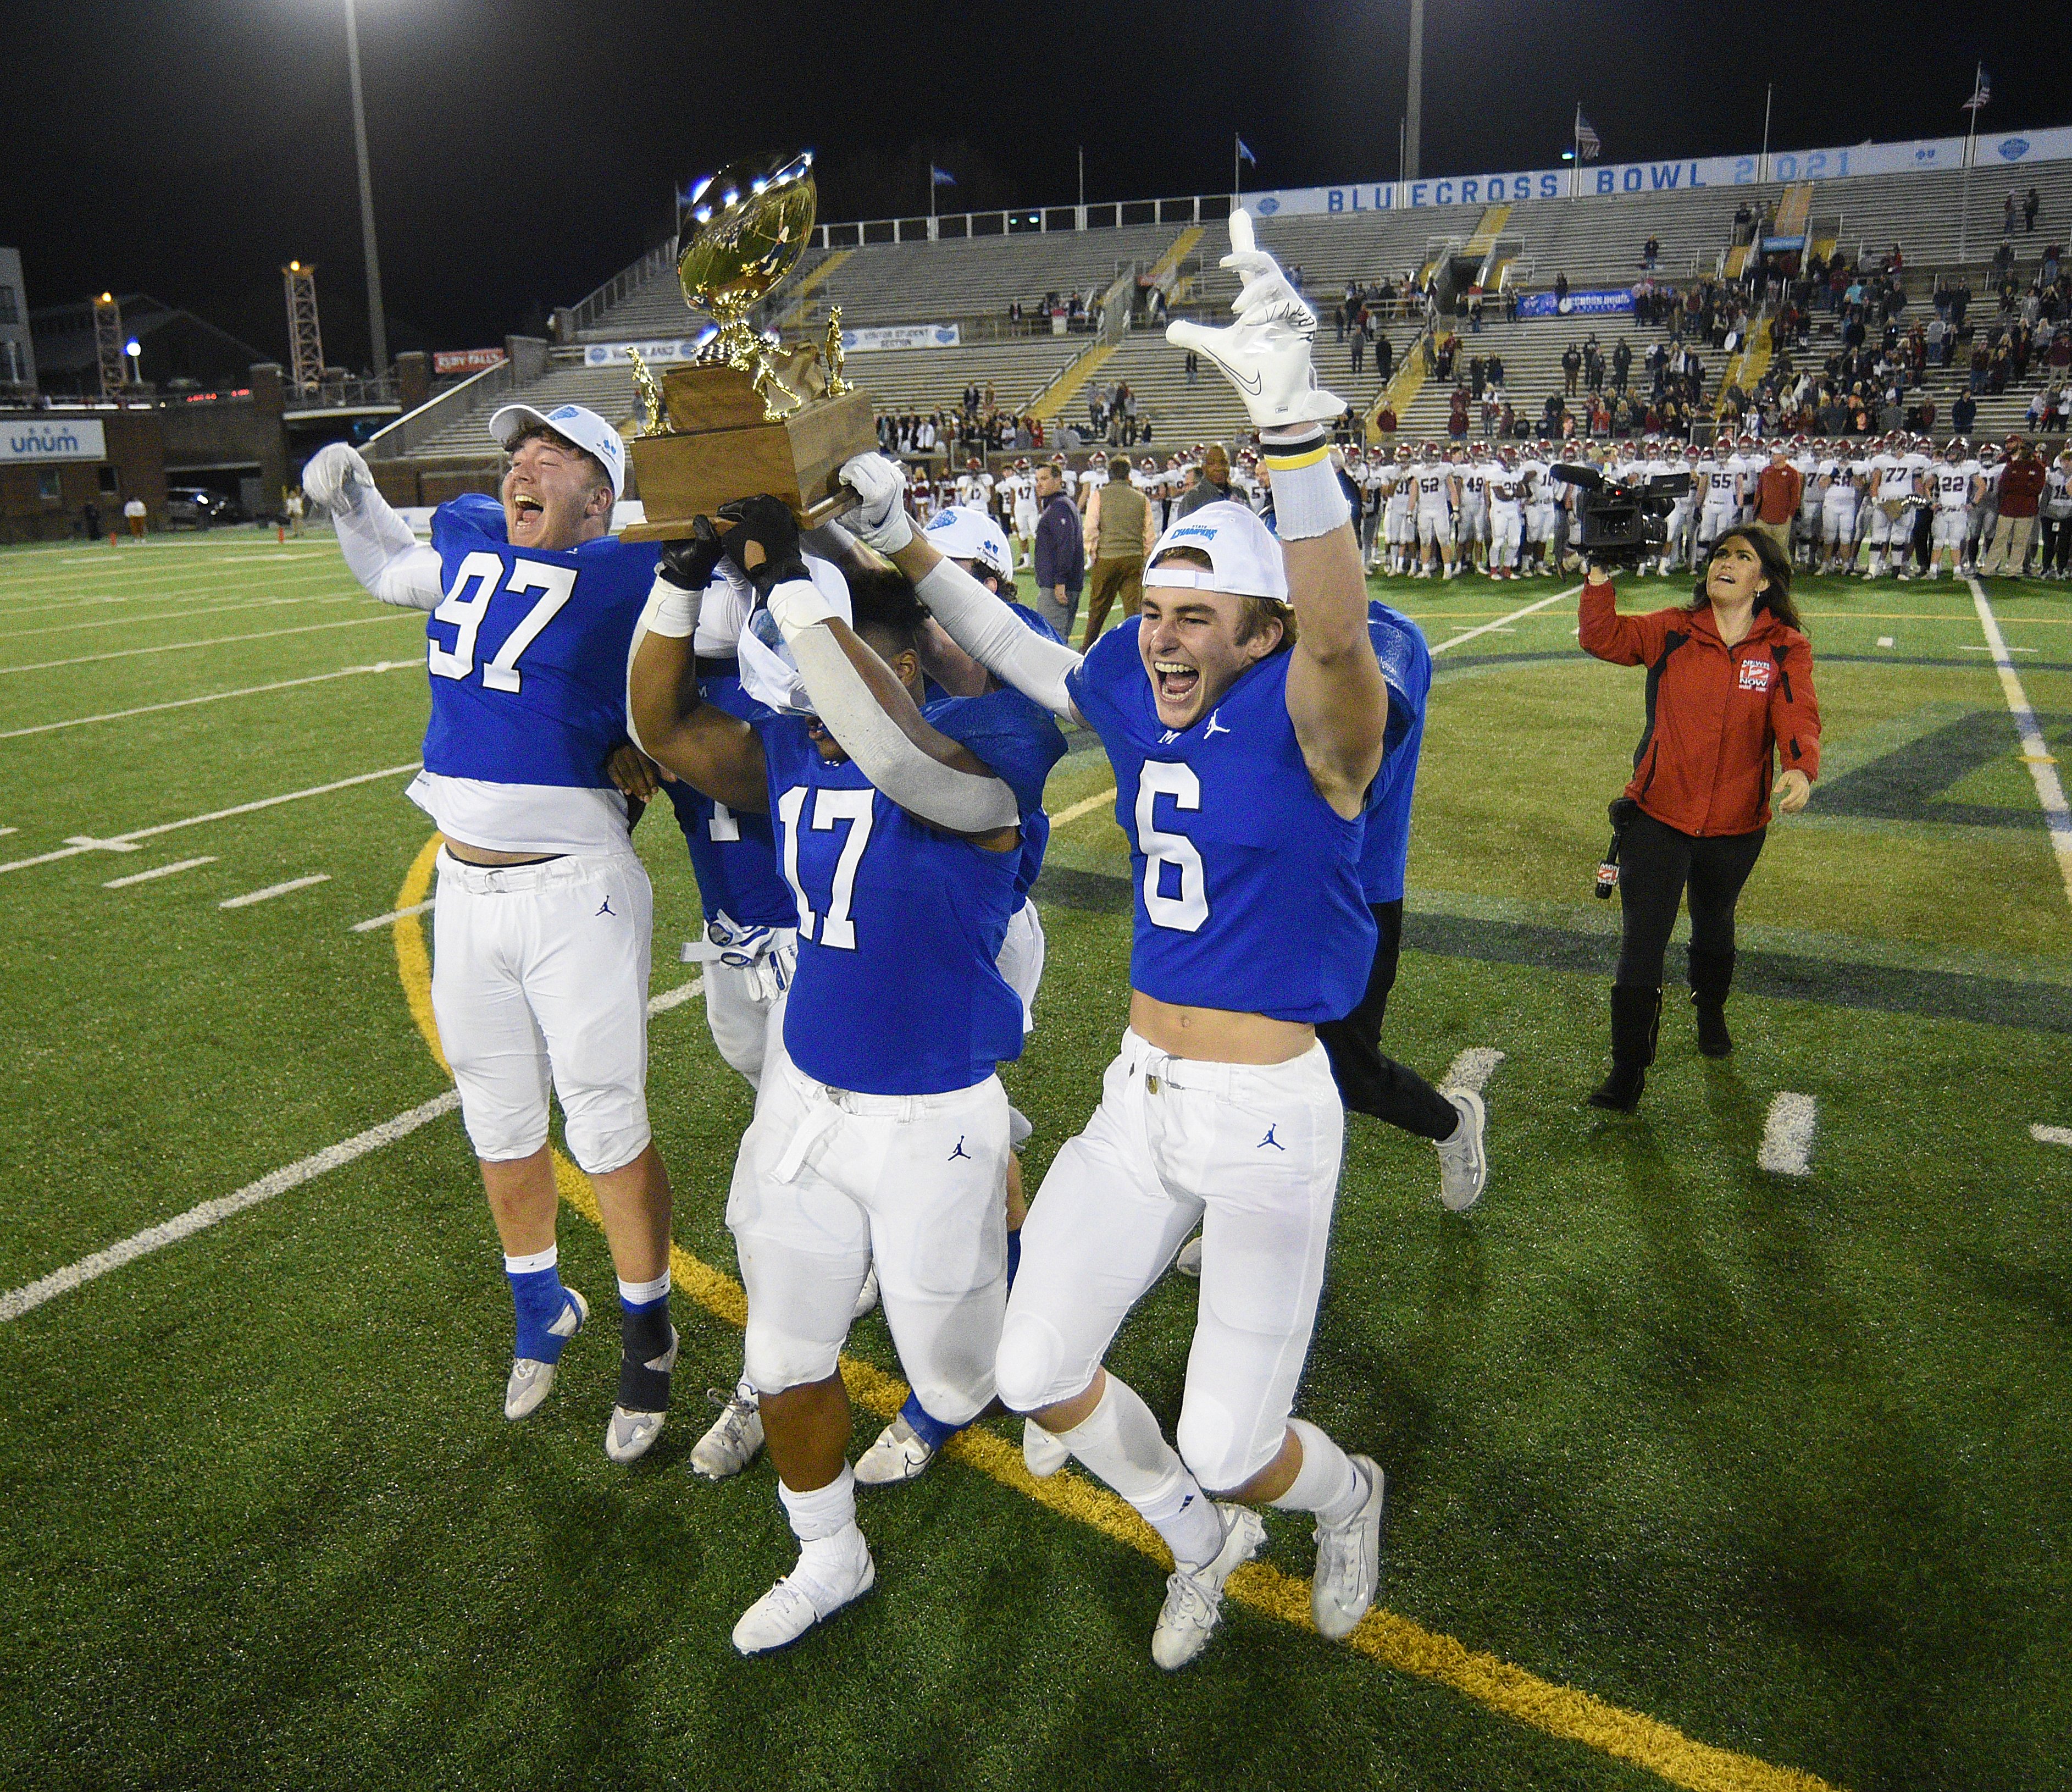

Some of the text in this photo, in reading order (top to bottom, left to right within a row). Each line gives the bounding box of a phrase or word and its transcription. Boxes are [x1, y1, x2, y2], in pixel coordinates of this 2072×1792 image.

[1328, 151, 1851, 212] BLUECROSS BOWL 2021
[12, 432, 78, 453] unum
[1885, 467, 1908, 483] 77
[1421, 477, 1438, 493] 52
[1466, 477, 1483, 493] 49
[1942, 476, 1964, 491] 22
[1018, 486, 1031, 500] 47
[1170, 528, 1218, 540] CHAMPIONS
[429, 551, 577, 693] 97
[1741, 666, 1769, 680] 12
[1135, 760, 1209, 932] 6
[778, 786, 875, 949] 17
